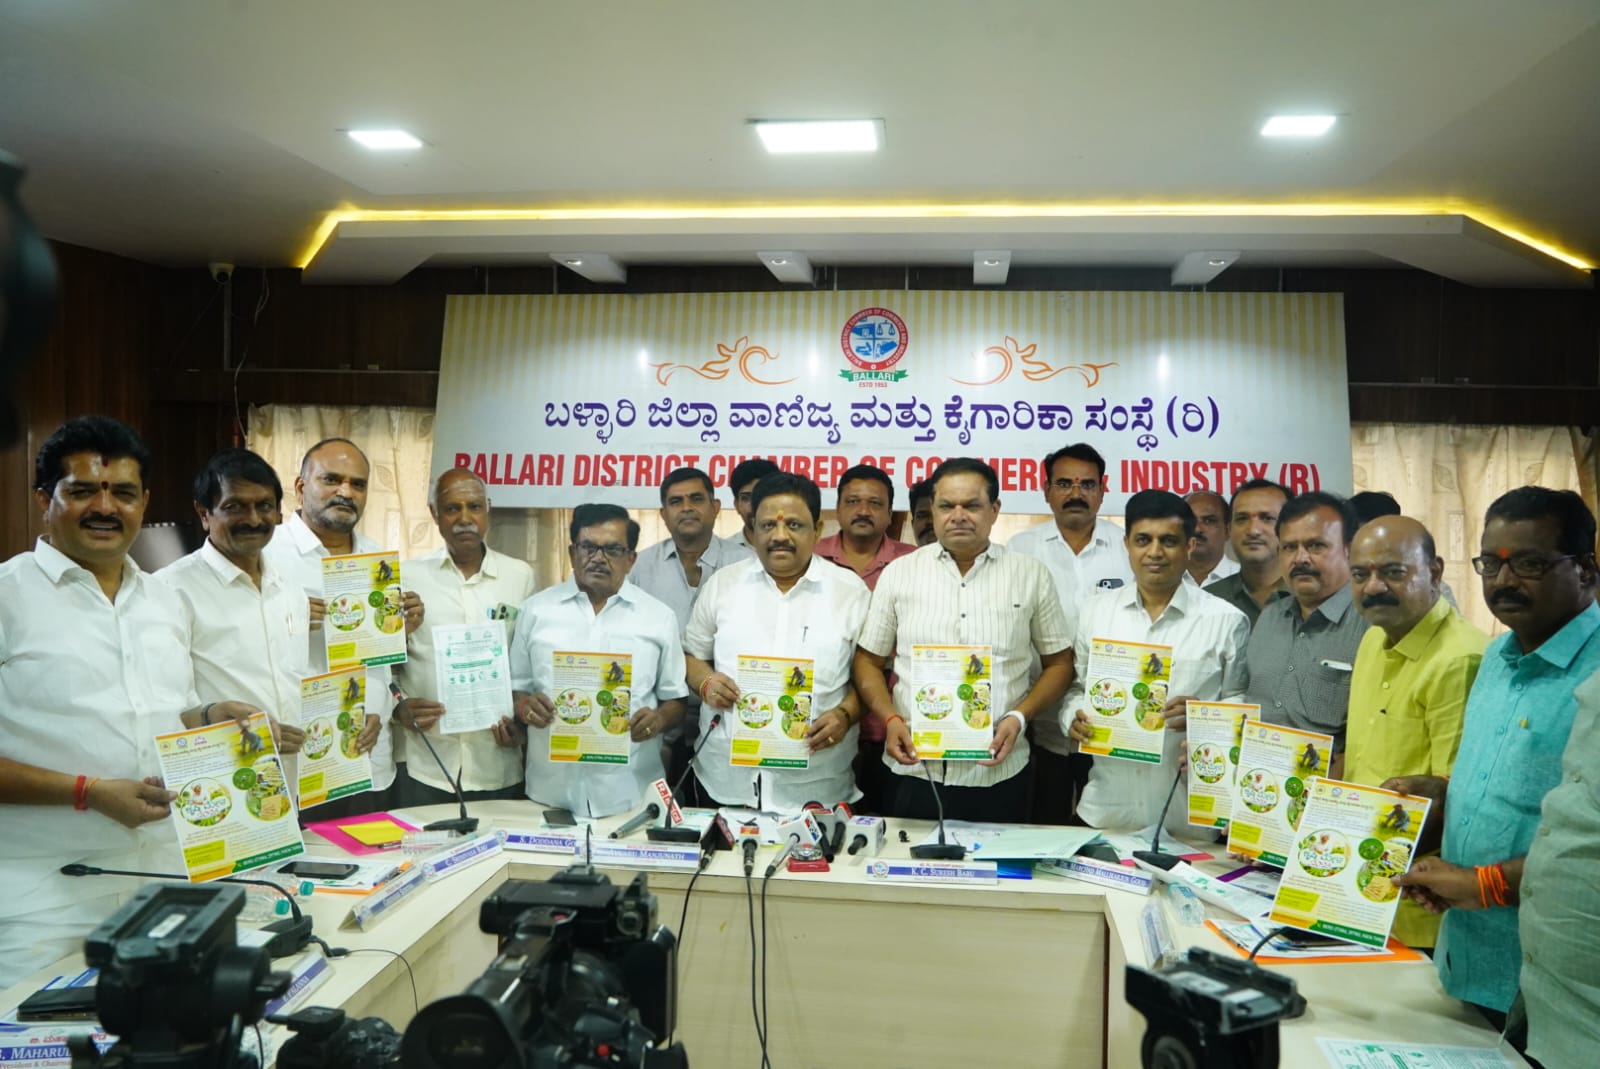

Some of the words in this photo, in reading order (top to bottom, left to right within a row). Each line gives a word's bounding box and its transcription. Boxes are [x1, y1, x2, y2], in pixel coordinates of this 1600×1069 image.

[852, 372, 895, 381] BALLARI
[544, 398, 637, 445] ಬಳ್ಳಾರಿ
[648, 397, 721, 442] ಜಿಲ್ಲಾ
[729, 395, 842, 444] ವಾಣಿಜ್ಯ
[850, 395, 937, 442] ಮತ್ತು
[944, 395, 1073, 446] ಕೈಗಾರಿಕಾ
[1085, 397, 1159, 452] ಸಂಸ್ಥೆ
[1166, 395, 1220, 438] (ರಿ)
[1278, 463, 1321, 497] (R)
